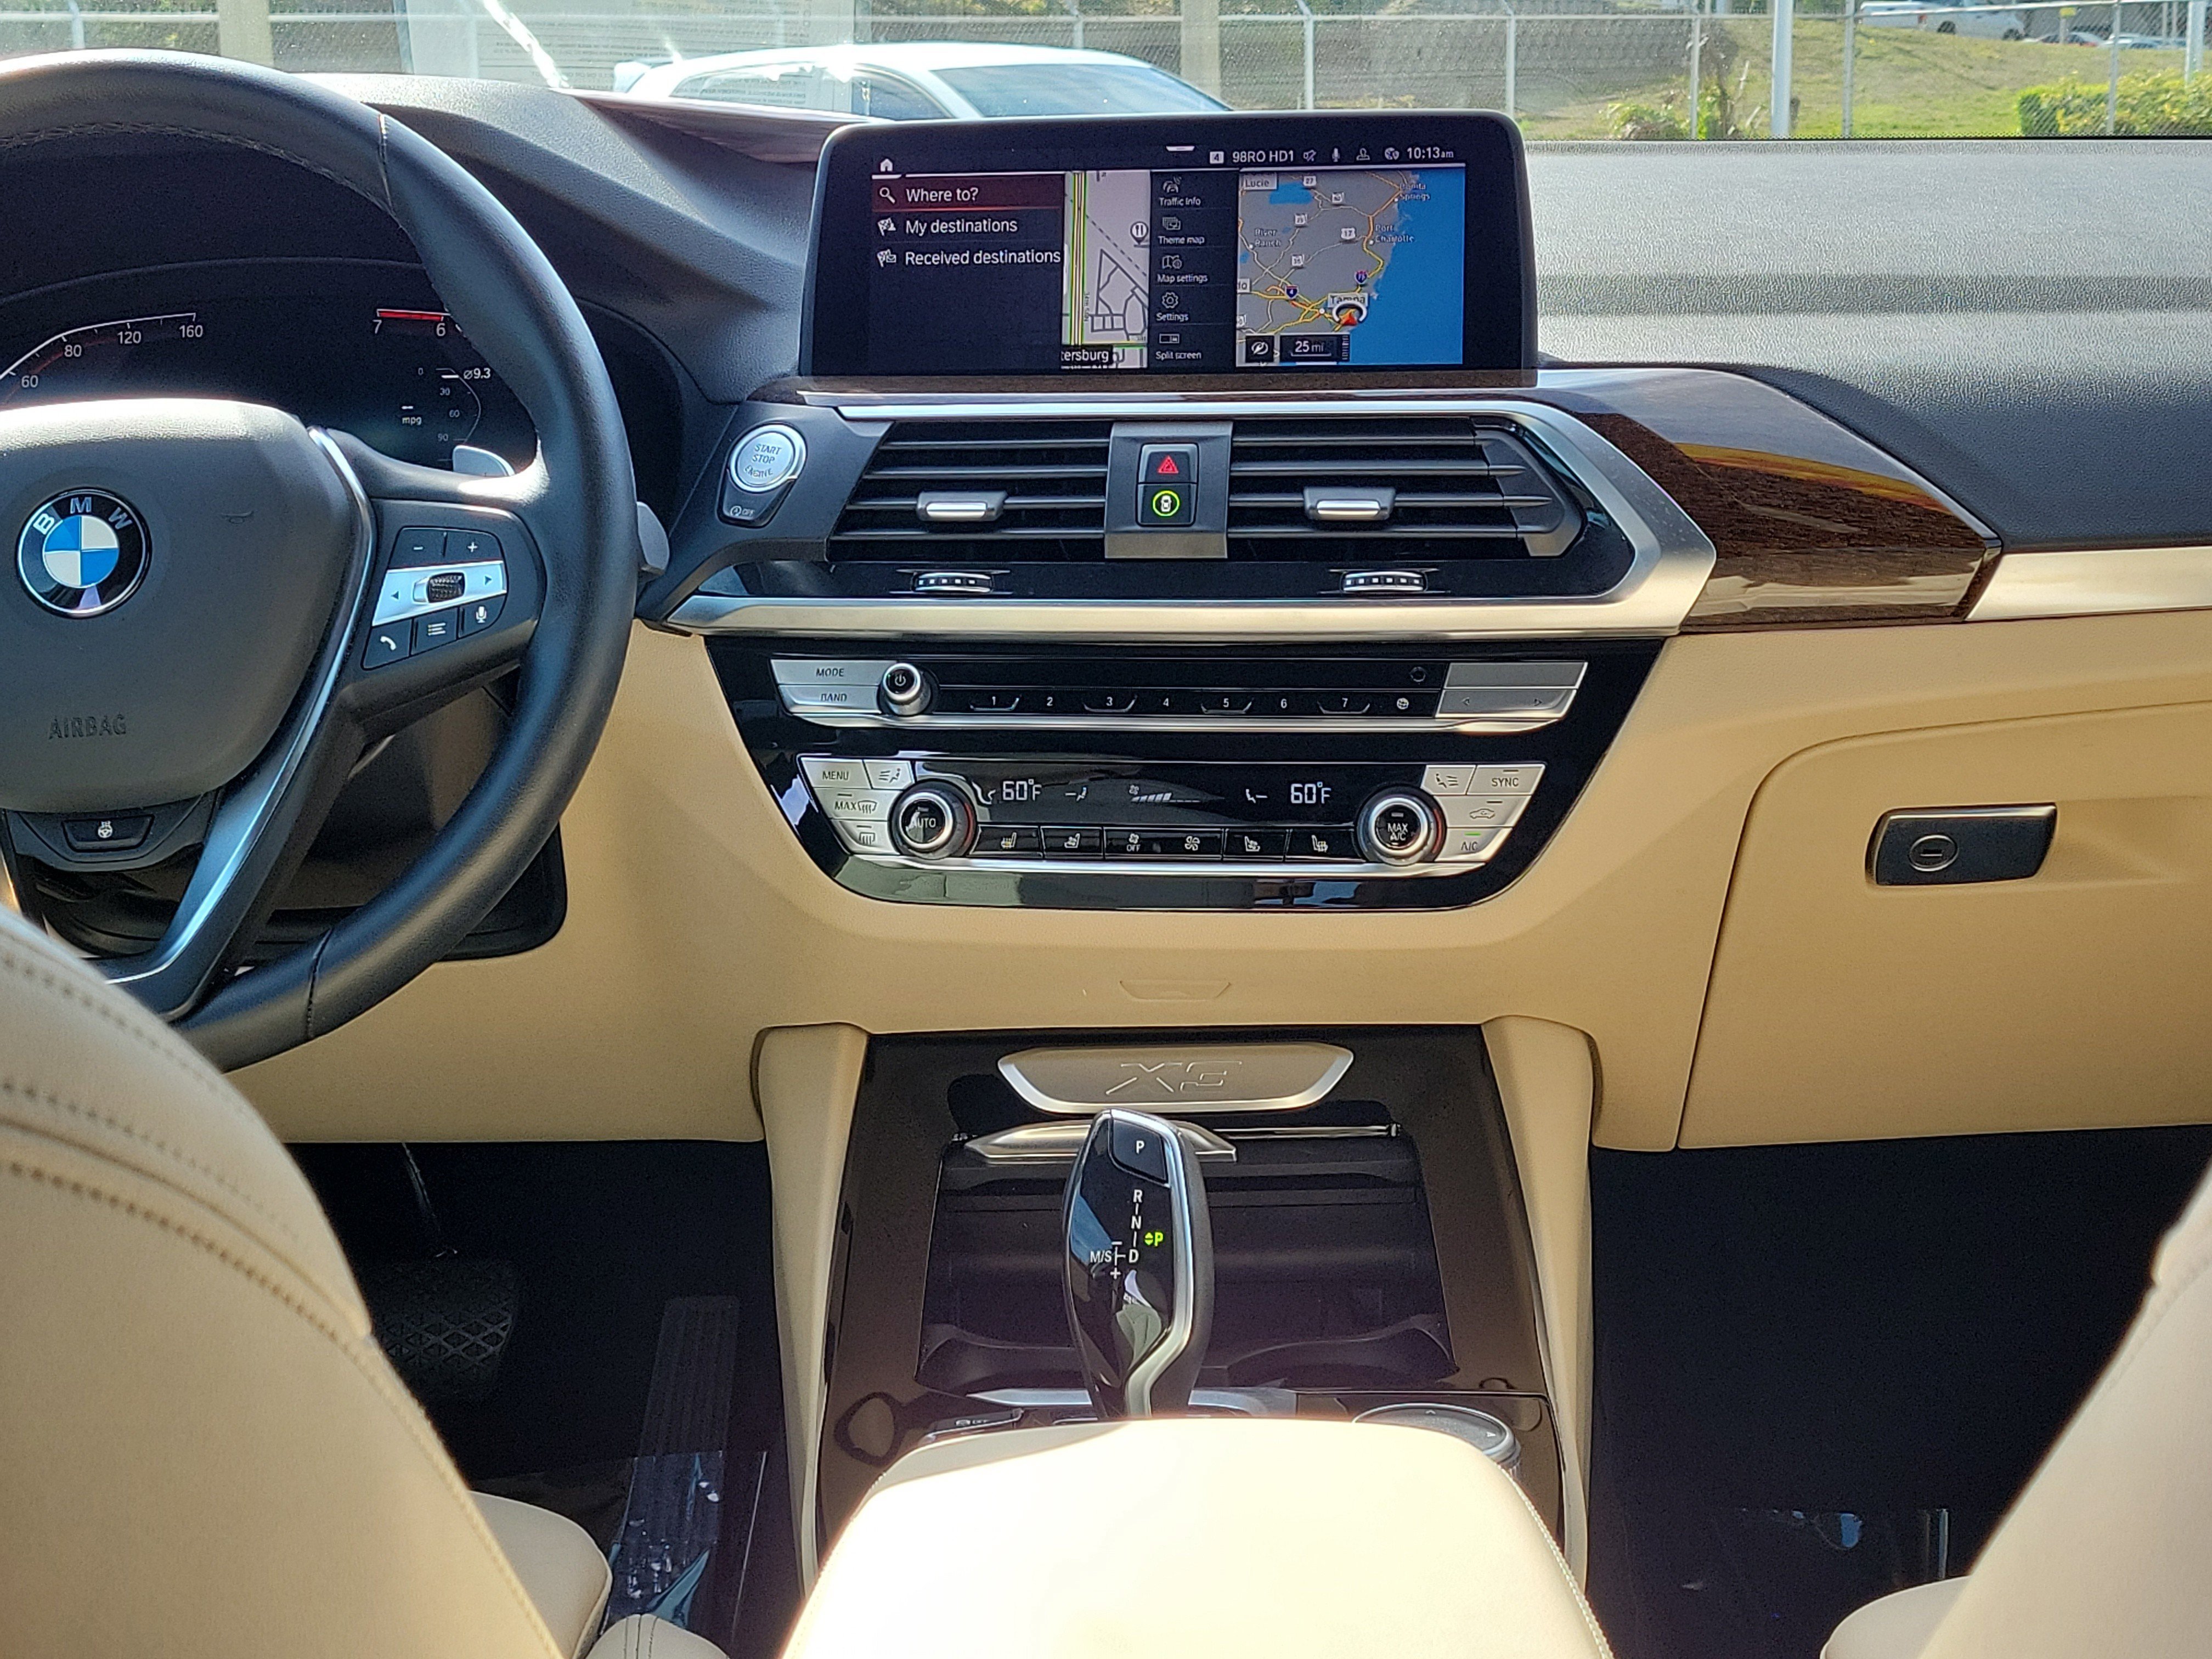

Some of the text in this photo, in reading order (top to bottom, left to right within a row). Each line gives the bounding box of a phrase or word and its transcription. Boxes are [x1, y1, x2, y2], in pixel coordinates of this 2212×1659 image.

[1232, 150, 1294, 162] 98RO HD1
[1407, 147, 1454, 159] 10:13am
[1245, 179, 1269, 188] Lucie
[906, 187, 978, 202] Where to?
[1159, 197, 1184, 206] Traffic
[906, 218, 1018, 236] My destinations
[1158, 235, 1205, 245] Theme map
[905, 249, 1061, 266] Received destinations
[1157, 274, 1208, 284] Map settings
[1156, 312, 1189, 322] Settings
[179, 324, 204, 338] 160
[373, 319, 382, 335] 7
[436, 323, 446, 337] 6
[118, 331, 142, 345] 120
[64, 344, 82, 357] 80
[1295, 341, 1324, 352] 25 mi
[21, 375, 38, 388] 60
[440, 387, 450, 396] 30
[402, 416, 422, 426] mpg
[754, 443, 782, 455] START
[752, 454, 775, 464] STOP
[33, 496, 133, 535] BMW
[816, 668, 844, 677] MODE
[821, 693, 848, 702] BAND
[991, 696, 996, 706] 1
[1046, 696, 1053, 706] 2
[1106, 696, 1113, 706] 3
[1163, 697, 1169, 707] 4
[1223, 698, 1229, 708] 5
[1280, 698, 1287, 708] 6
[1342, 697, 1348, 708] 7
[49, 713, 126, 740] AIRBAG
[822, 770, 849, 781] MENU
[1491, 777, 1519, 787] SYNC
[834, 801, 857, 811] MAX
[1387, 822, 1408, 832] MAX
[1390, 831, 1406, 841] A/C
[1460, 841, 1479, 851] A/C
[1136, 1140, 1145, 1154] P
[1133, 1189, 1143, 1203] R
[1131, 1215, 1142, 1229] N
[1154, 1232, 1164, 1246] P
[1090, 1250, 1112, 1263] M/S
[1128, 1249, 1139, 1263] D
